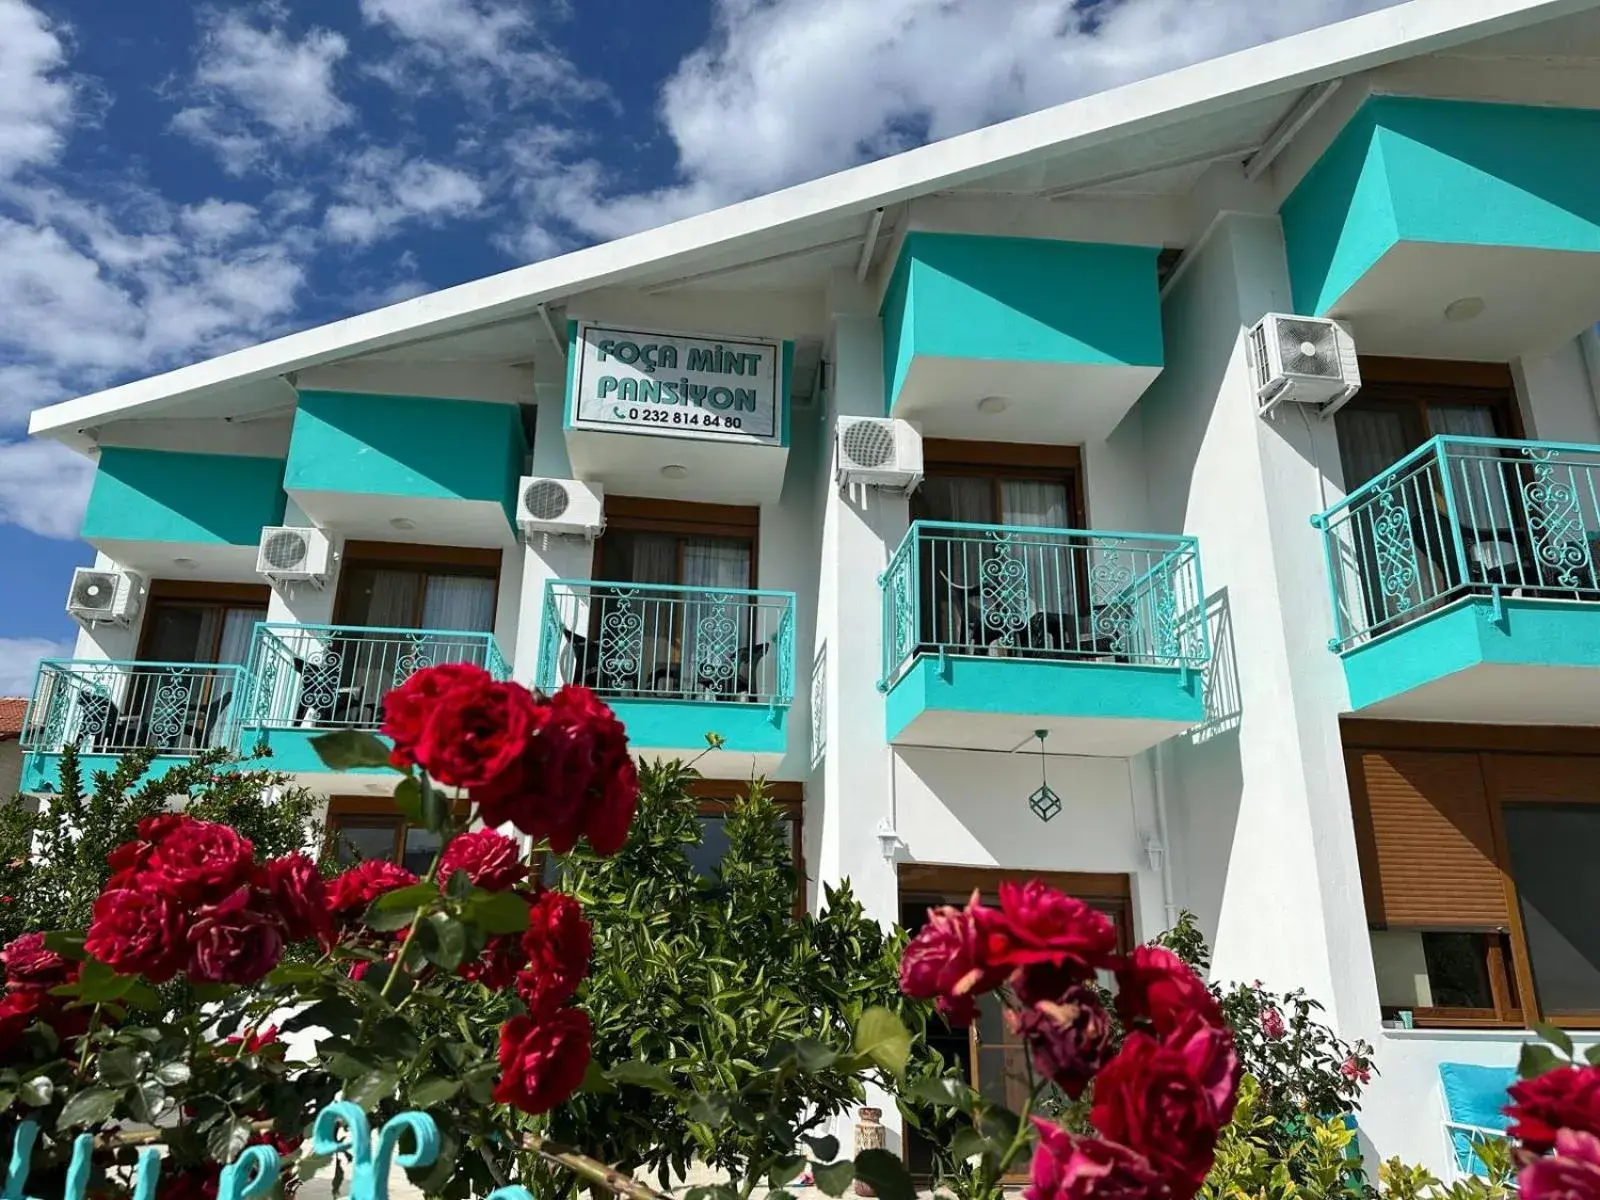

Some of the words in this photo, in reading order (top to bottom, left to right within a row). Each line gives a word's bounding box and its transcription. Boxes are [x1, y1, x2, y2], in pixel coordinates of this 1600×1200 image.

[597, 339, 678, 373] FOÇA
[686, 344, 762, 376] MİNT
[597, 376, 756, 412] PANSİYON
[629, 408, 639, 420] 0
[643, 409, 669, 423] 232
[673, 412, 699, 425] 814
[703, 414, 720, 427] 84
[724, 416, 741, 429] 80
